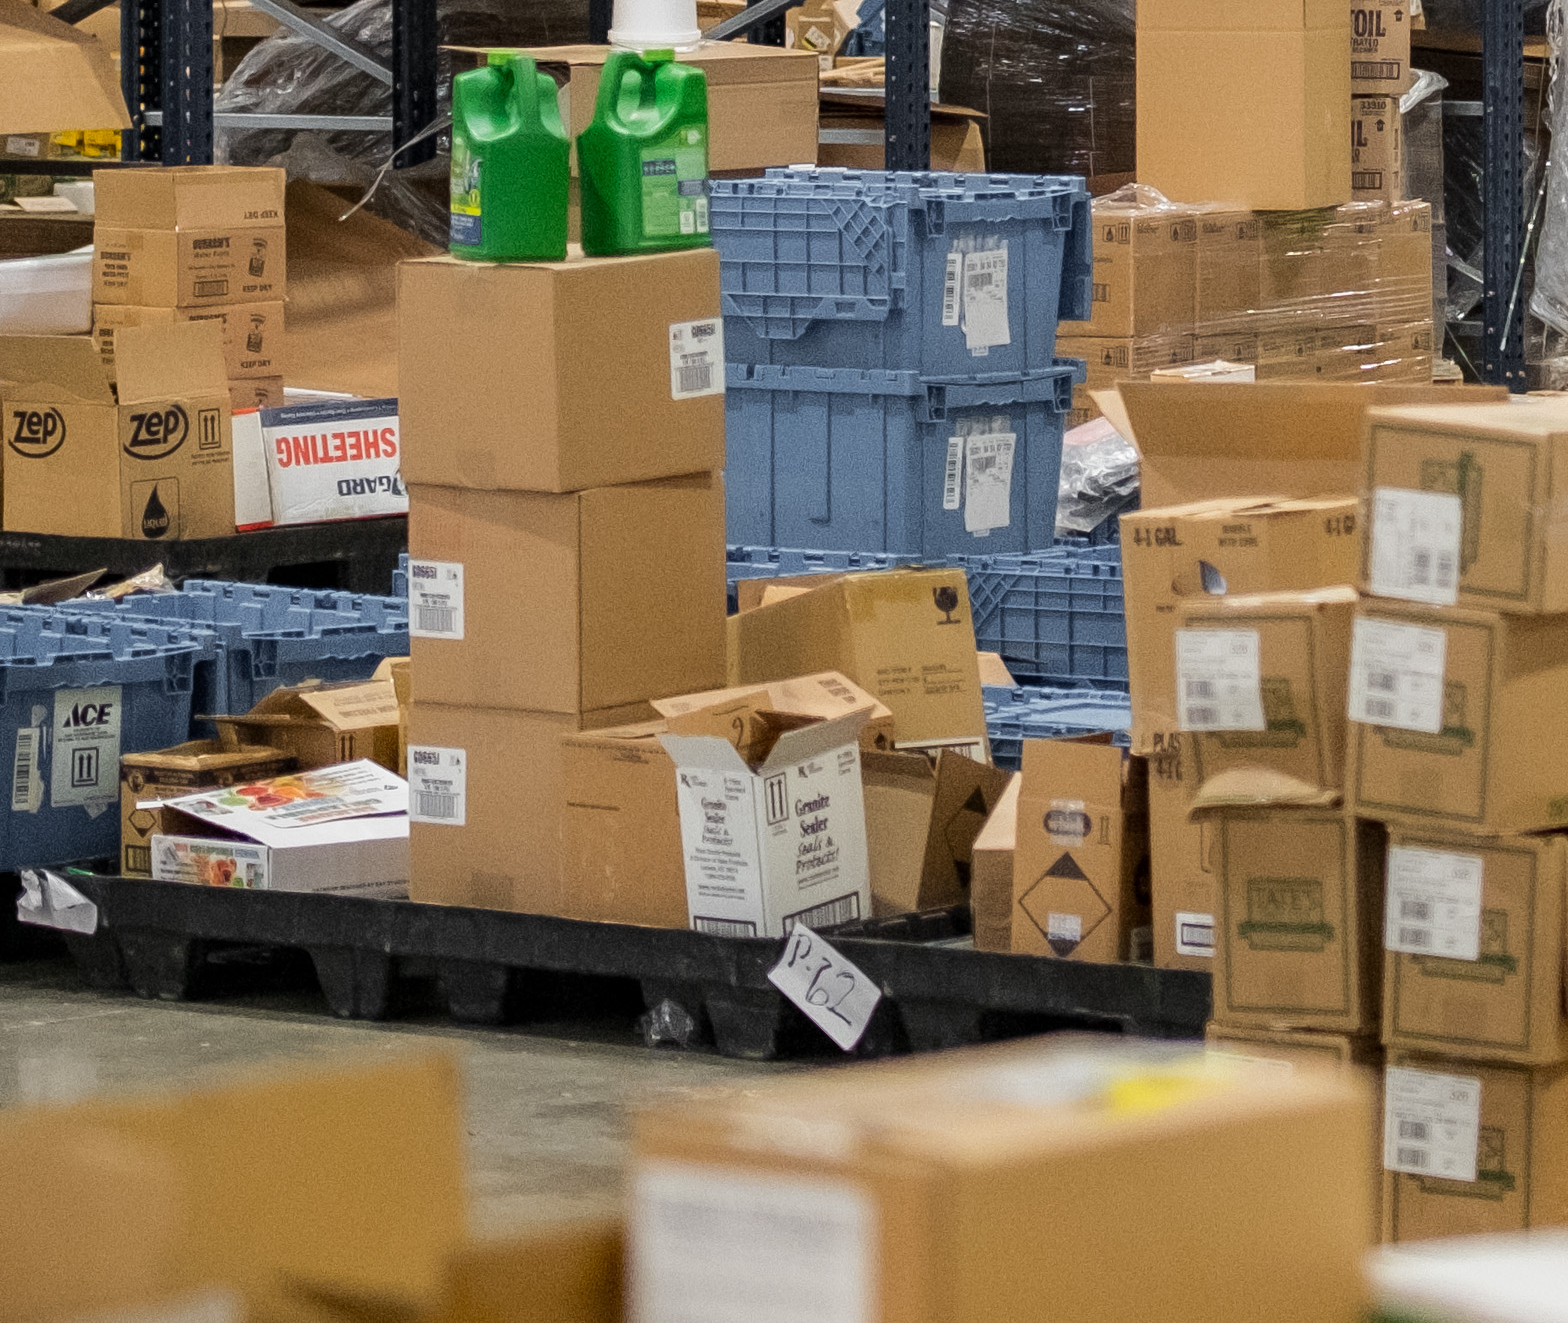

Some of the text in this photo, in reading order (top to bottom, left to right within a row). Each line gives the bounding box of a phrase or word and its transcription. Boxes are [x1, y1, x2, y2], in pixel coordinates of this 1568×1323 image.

[276, 428, 397, 468] SHEETING
[63, 701, 113, 728] ACE
[795, 793, 831, 818] Granite
